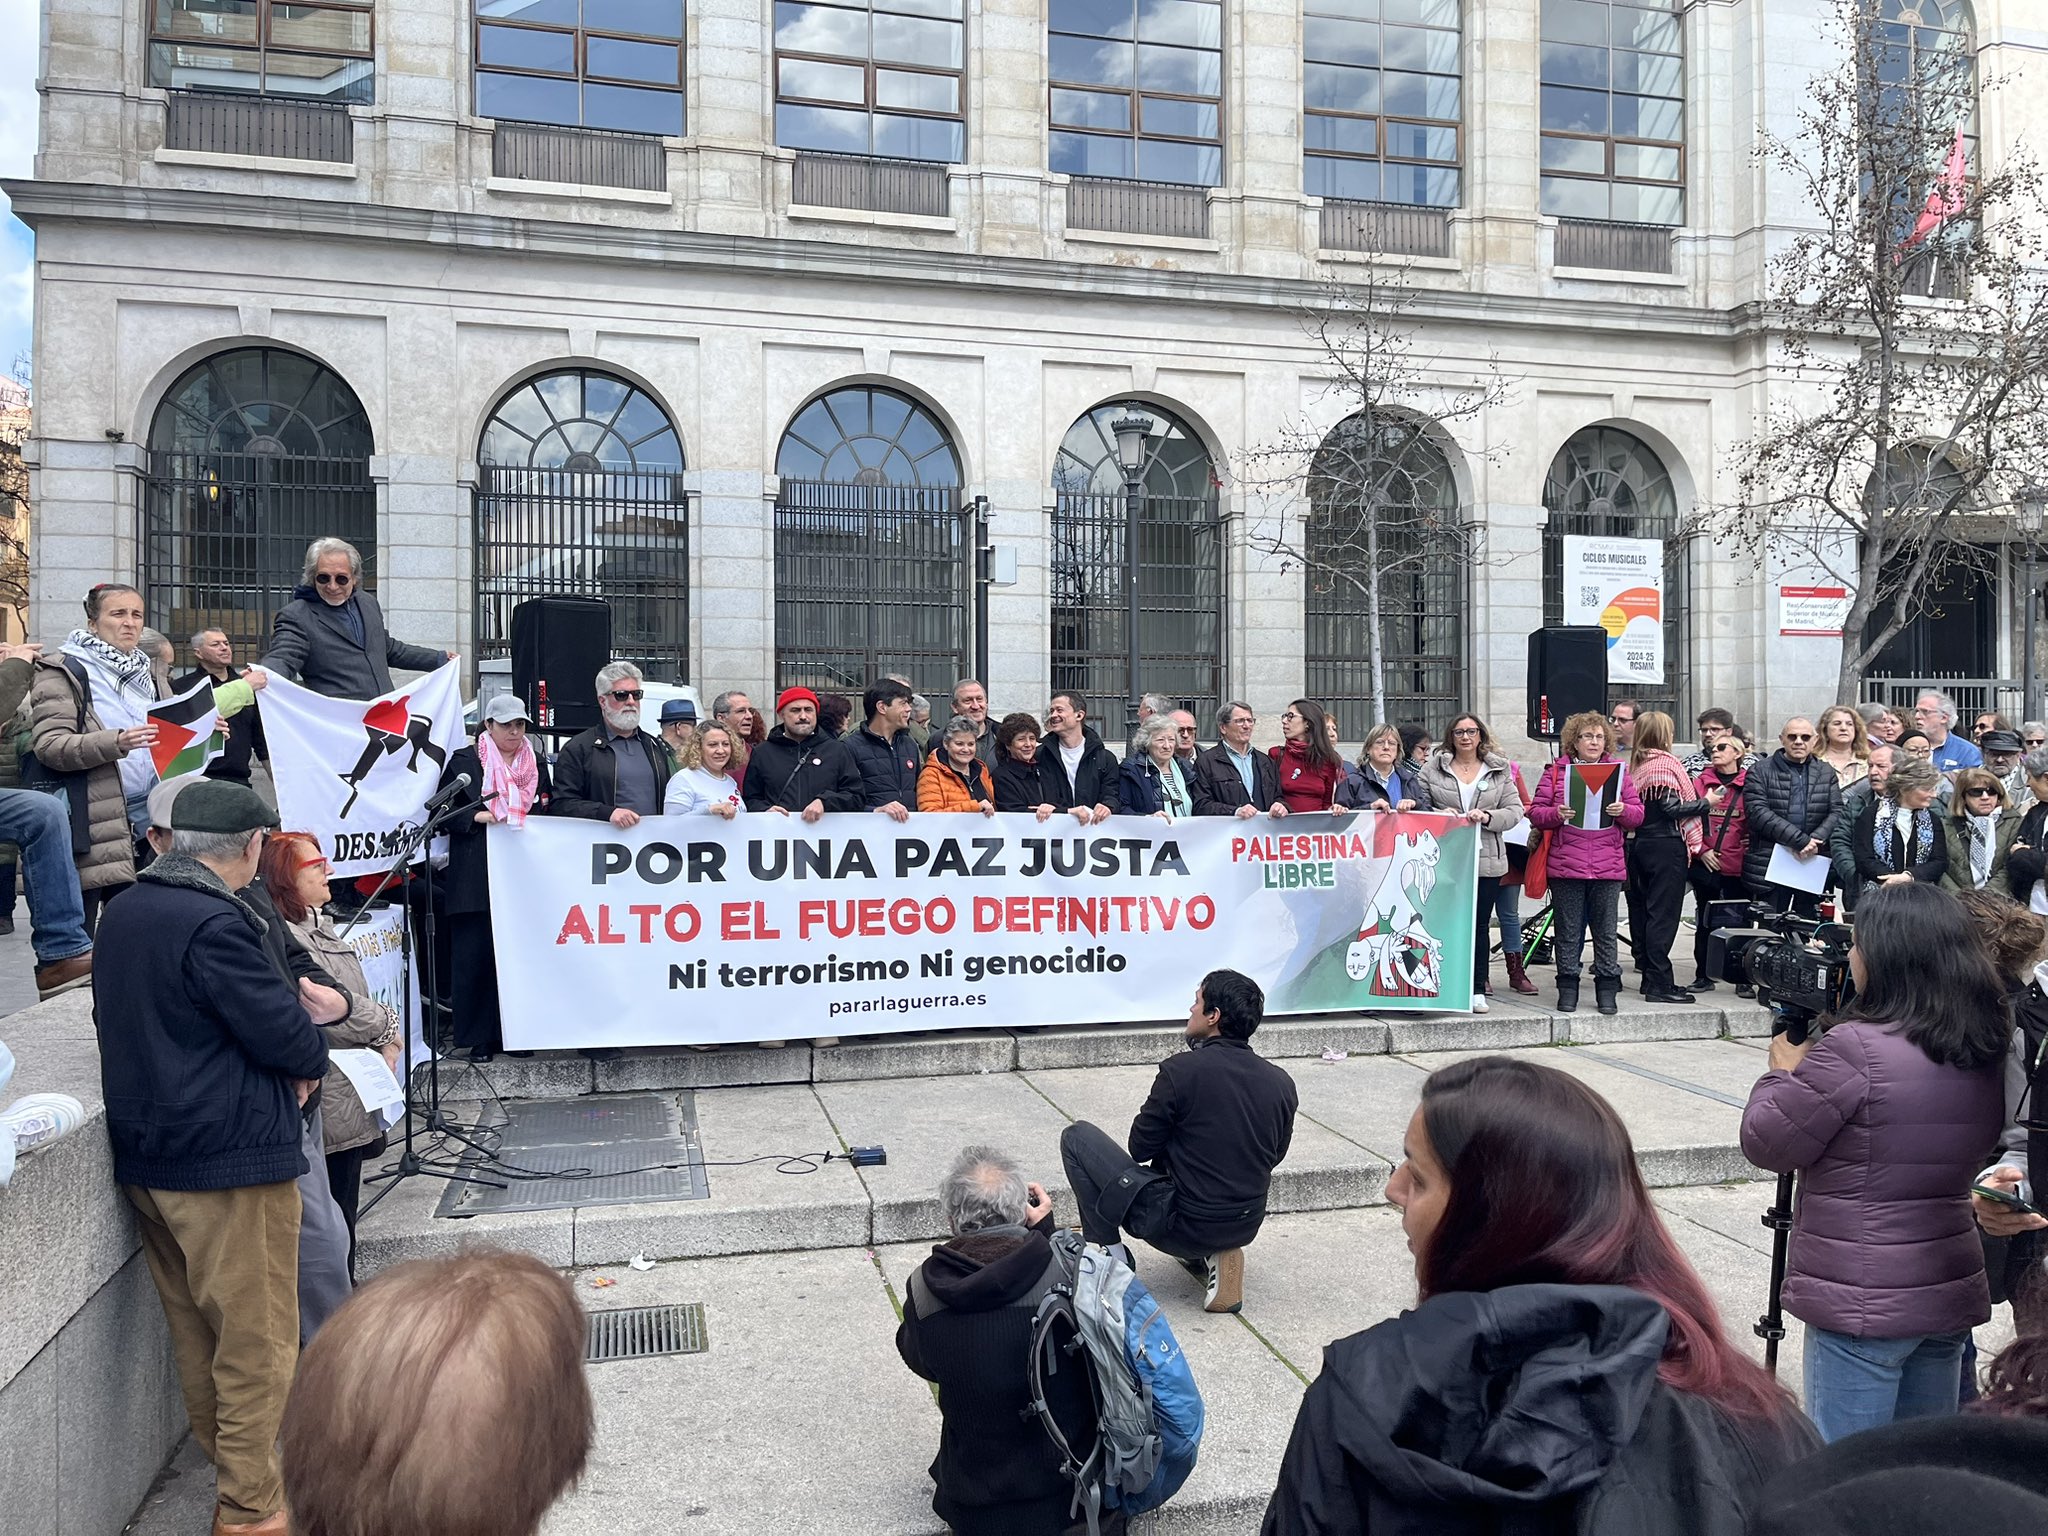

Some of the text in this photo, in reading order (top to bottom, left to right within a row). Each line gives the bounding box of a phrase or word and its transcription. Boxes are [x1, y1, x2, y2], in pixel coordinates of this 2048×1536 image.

[1582, 552, 1647, 566] CICLOS MUSICALES
[1627, 652, 1654, 661] 2024-25
[1630, 661, 1655, 671] RCSMM
[592, 838, 1190, 884] POR UNA PAZ JUSTA
[1231, 834, 1367, 862] PALESTINA
[1264, 861, 1334, 889] LIBRE
[556, 894, 1216, 945] ALTO EL FUEGO DEFINITIVO
[669, 947, 1127, 989] Ni terrorismo Ni genocidio
[829, 992, 987, 1018] pararlaguerra.es
